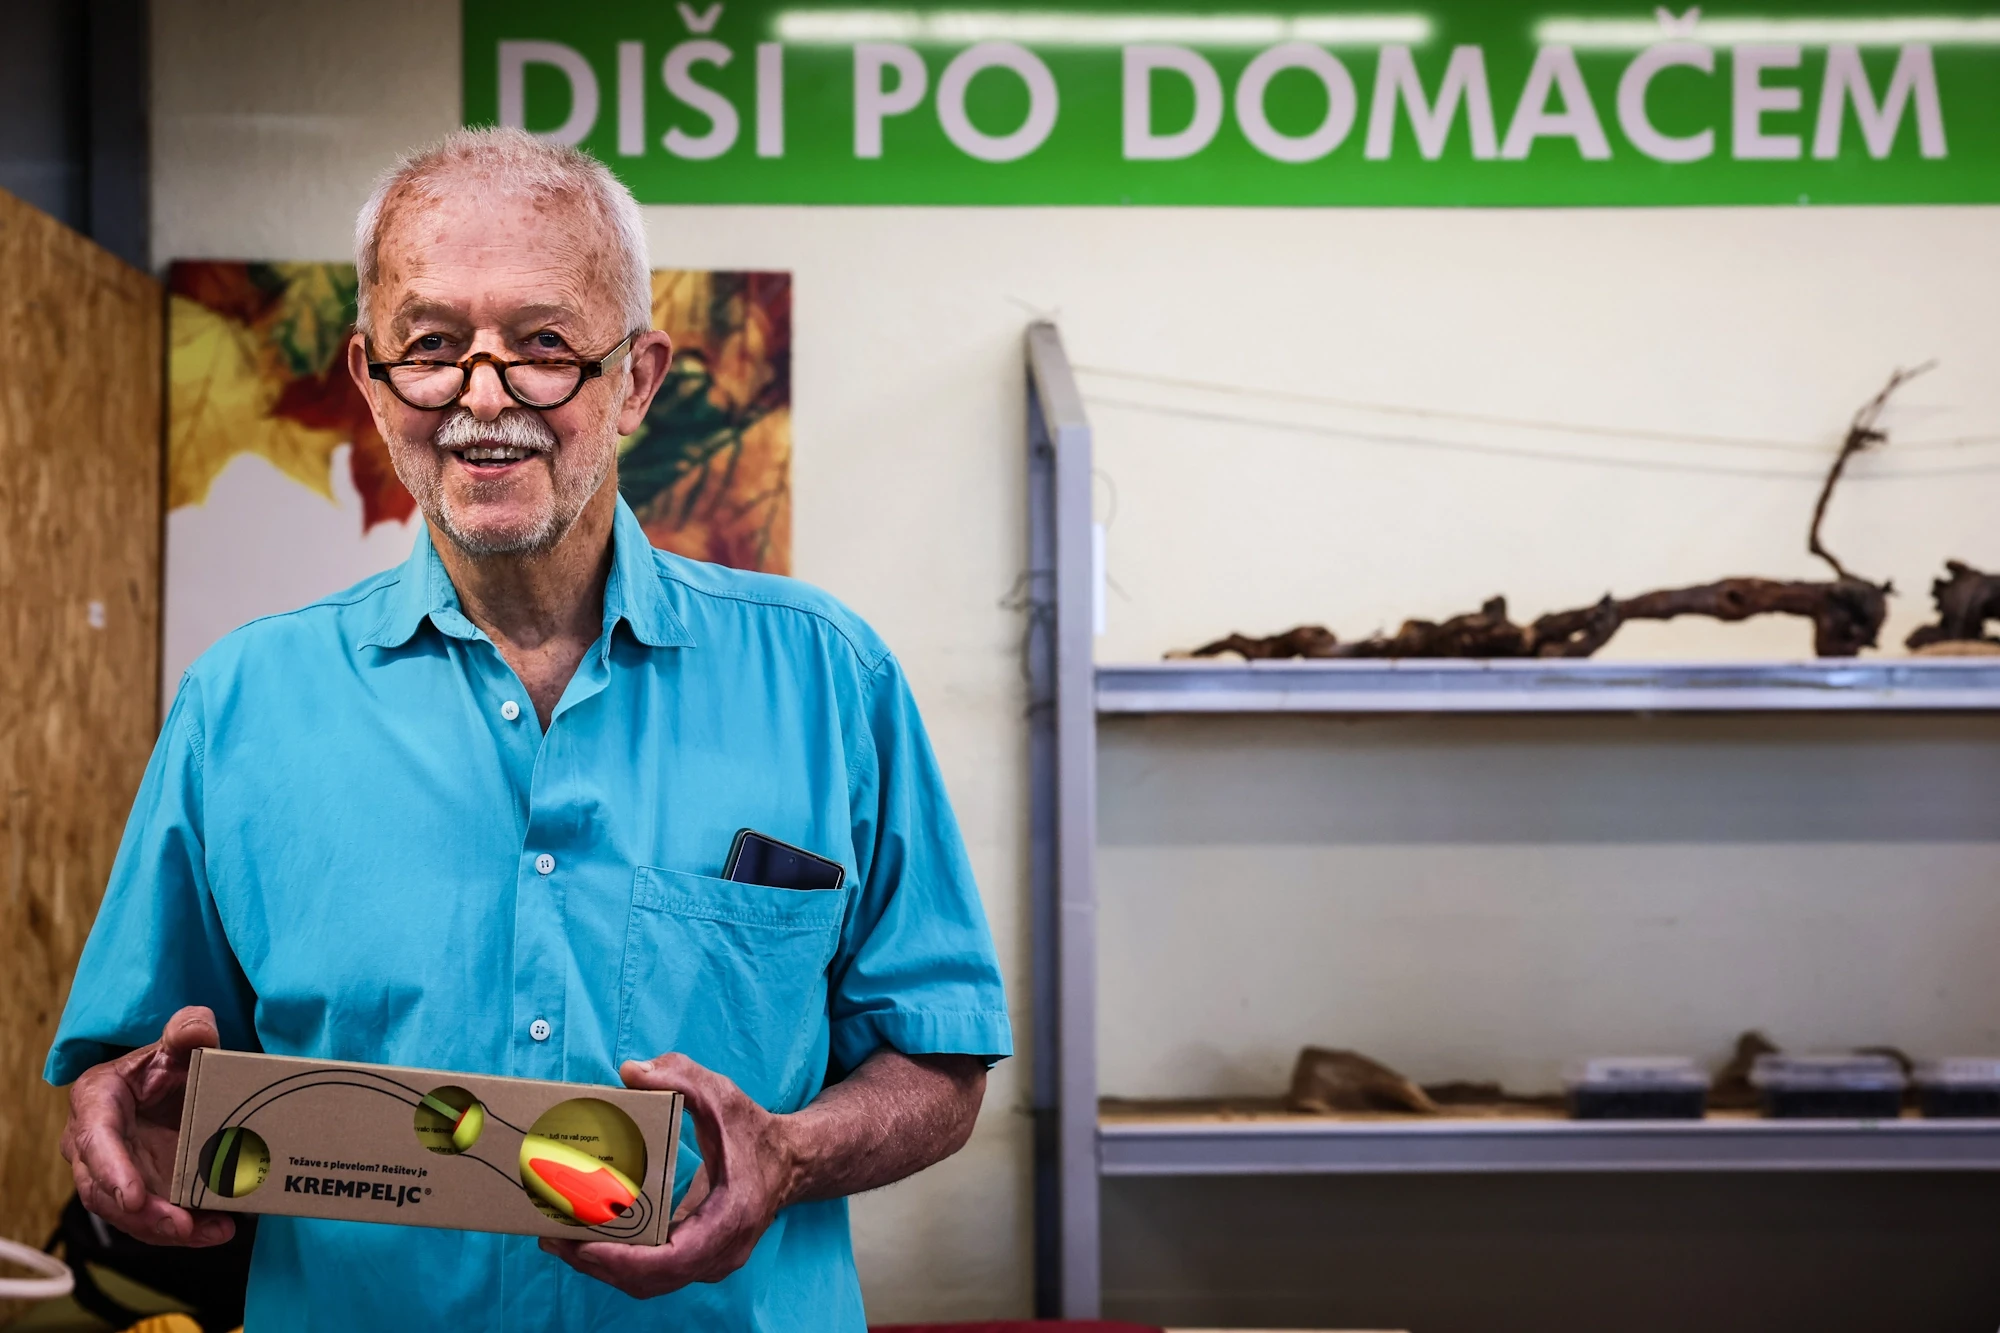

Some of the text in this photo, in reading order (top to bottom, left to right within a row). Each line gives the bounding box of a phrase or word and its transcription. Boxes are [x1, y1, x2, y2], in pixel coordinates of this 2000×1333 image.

[498, 3, 1948, 163] DIŠI PO DOMAČEM
[289, 1156, 321, 1168] Težave
[330, 1161, 380, 1173] plevelom?
[381, 1164, 417, 1176] Rešitev
[417, 1167, 428, 1178] je
